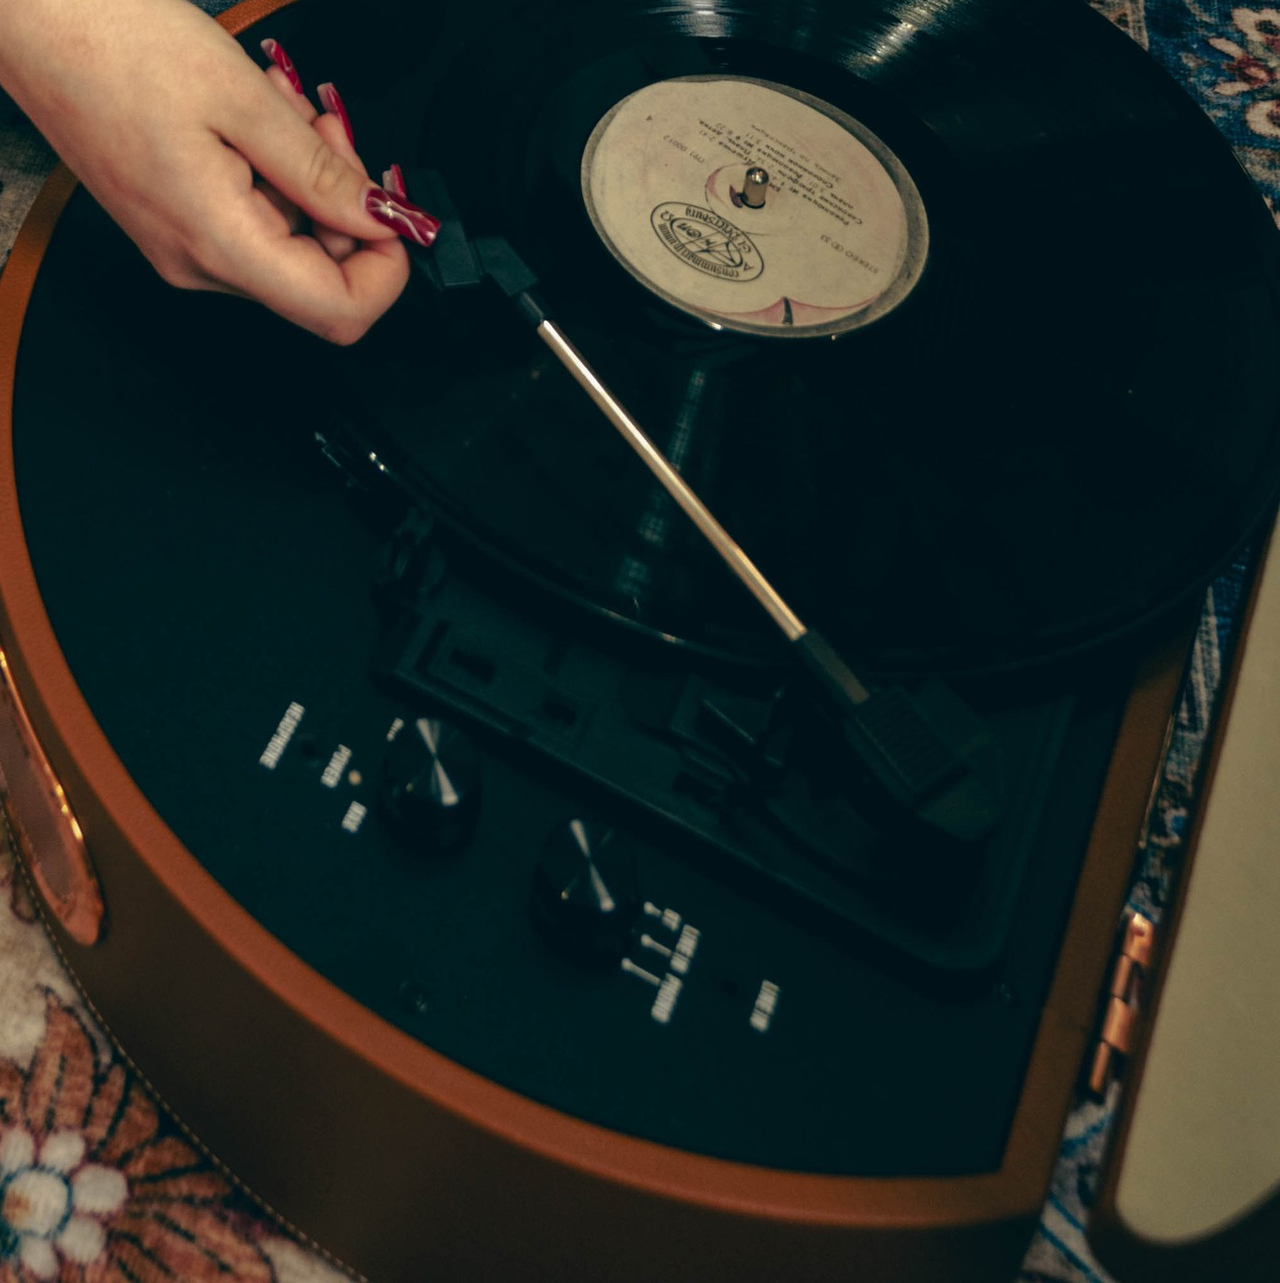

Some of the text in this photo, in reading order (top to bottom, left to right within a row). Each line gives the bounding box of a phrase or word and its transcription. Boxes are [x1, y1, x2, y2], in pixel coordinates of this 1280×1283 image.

[259, 701, 305, 770] HEADPHONE
[321, 744, 352, 788] POWER
[342, 801, 367, 833] MAX
[676, 924, 700, 959] LINE
[754, 979, 780, 1015] LINE
